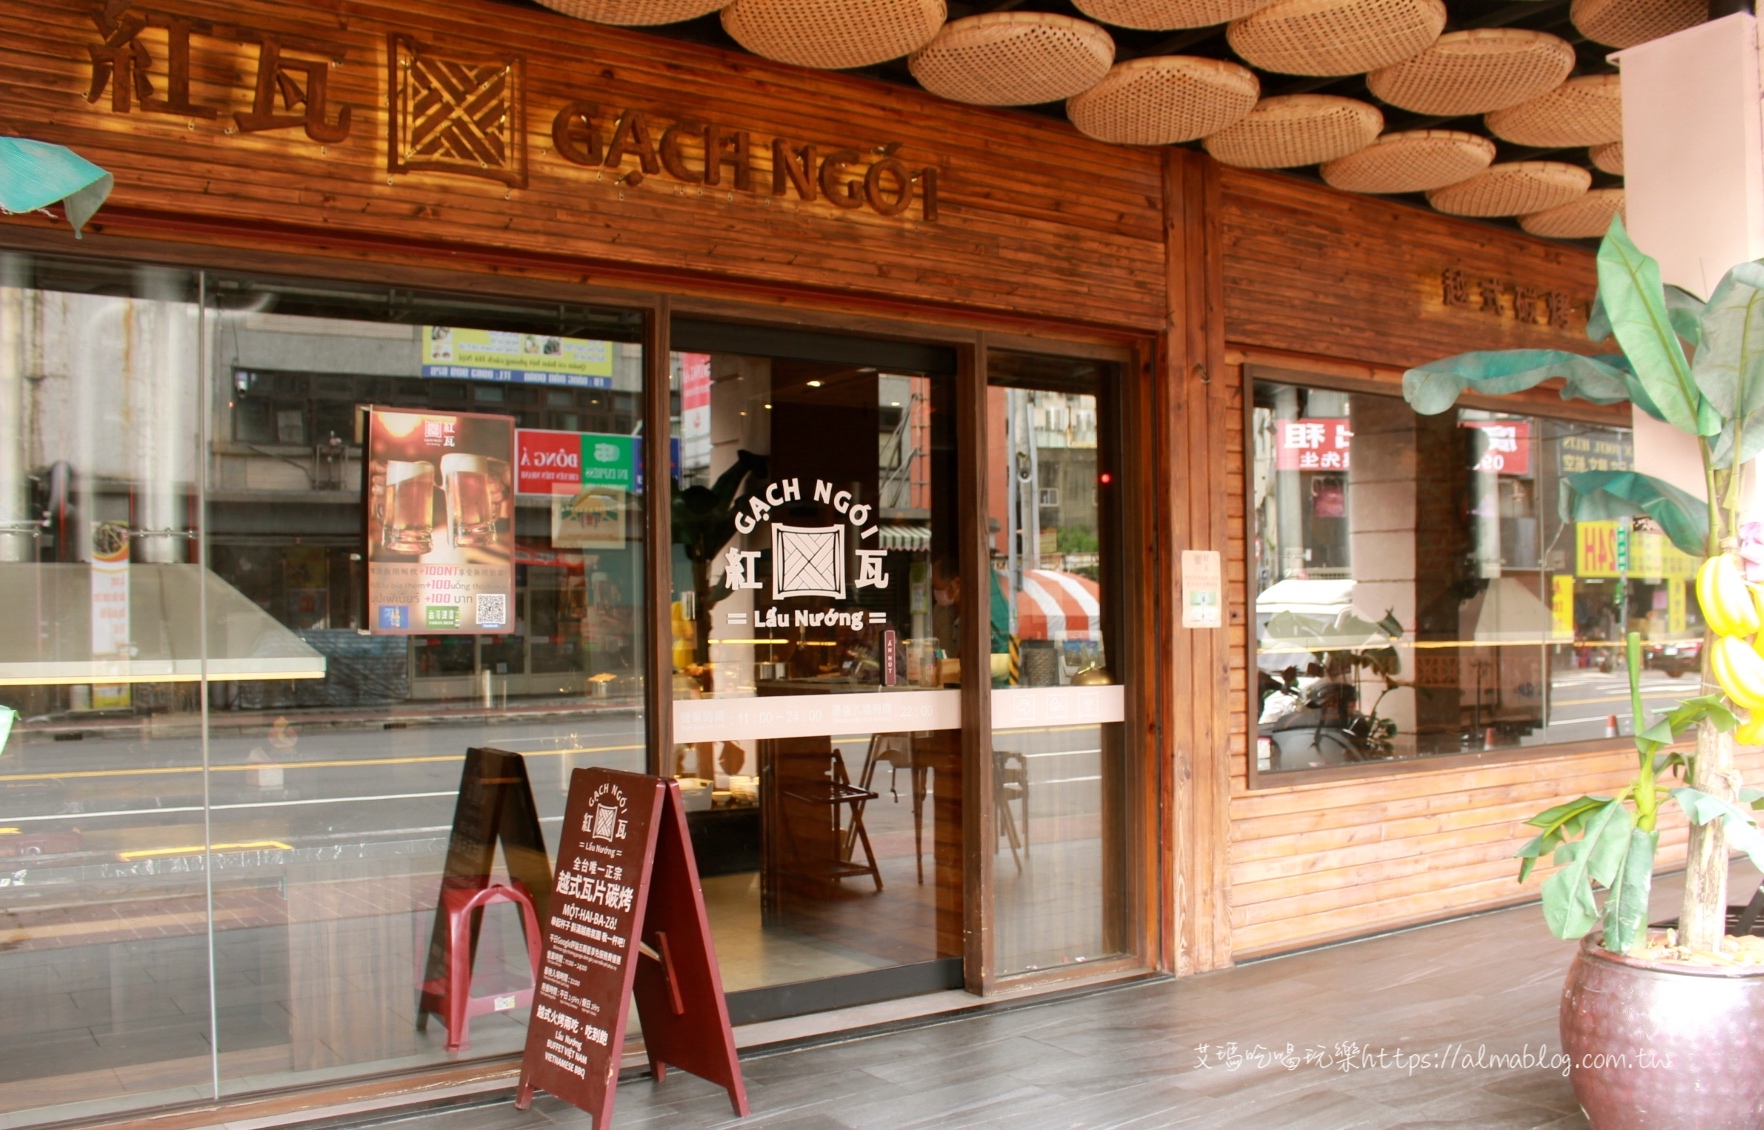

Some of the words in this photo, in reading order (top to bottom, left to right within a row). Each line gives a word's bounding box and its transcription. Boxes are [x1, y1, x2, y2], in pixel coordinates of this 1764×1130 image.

[87, 0, 352, 143] 紅瓦
[551, 100, 754, 192] GẠCH
[772, 140, 939, 222] NGÓI
[1441, 268, 1591, 328] 越式碳烤
[735, 478, 801, 534] GẠCH
[813, 479, 879, 540] NGÓI
[795, 608, 864, 631] Nướng
[573, 856, 623, 881] 全台唯一正宗
[556, 870, 634, 913] 越式瓦片碳烤
[545, 1051, 574, 1072] VIETNAMESE
[574, 1066, 586, 1080] BBQ
[546, 1039, 564, 1054] BUFFET
[575, 1052, 588, 1065] NAM
